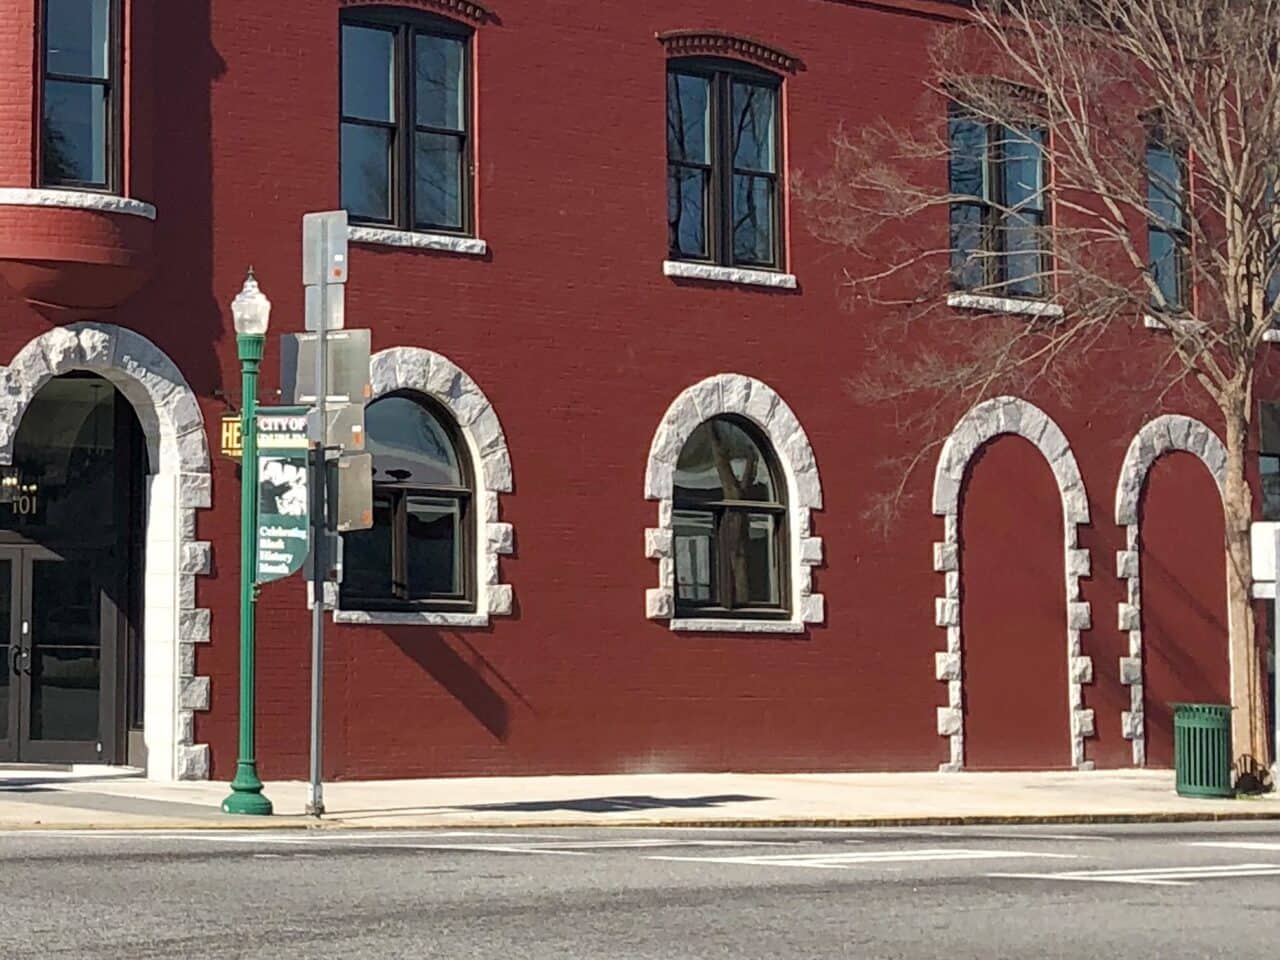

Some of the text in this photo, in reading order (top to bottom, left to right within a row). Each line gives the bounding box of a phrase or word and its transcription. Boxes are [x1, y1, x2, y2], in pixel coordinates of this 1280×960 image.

[260, 417, 306, 431] CITY OF
[12, 495, 37, 514] 101
[259, 550, 294, 564] History
